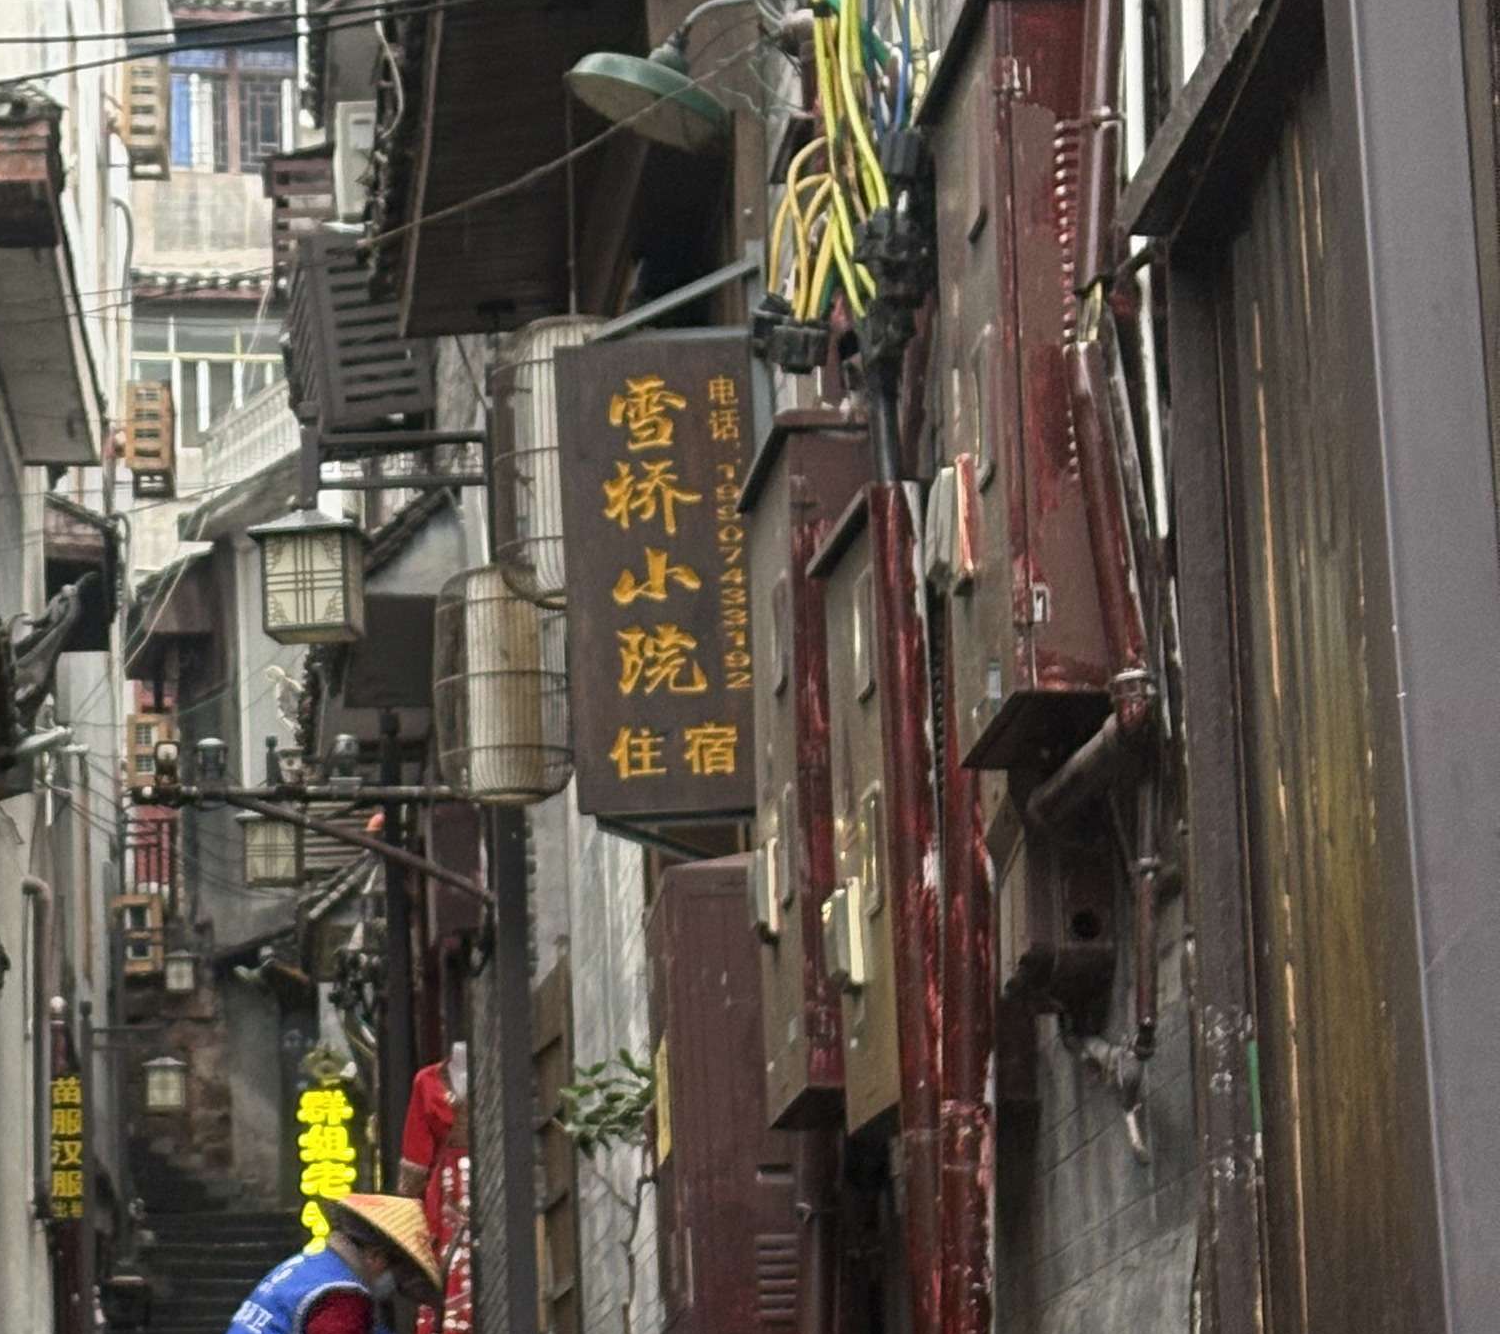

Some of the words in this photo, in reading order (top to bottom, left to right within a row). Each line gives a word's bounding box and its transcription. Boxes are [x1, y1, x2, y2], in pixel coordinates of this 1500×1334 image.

[602, 372, 709, 696] 雪桥小院
[608, 720, 739, 780] 住宿
[49, 1076, 84, 1198] 苗服汉服
[297, 1089, 358, 1256] 群姐老
